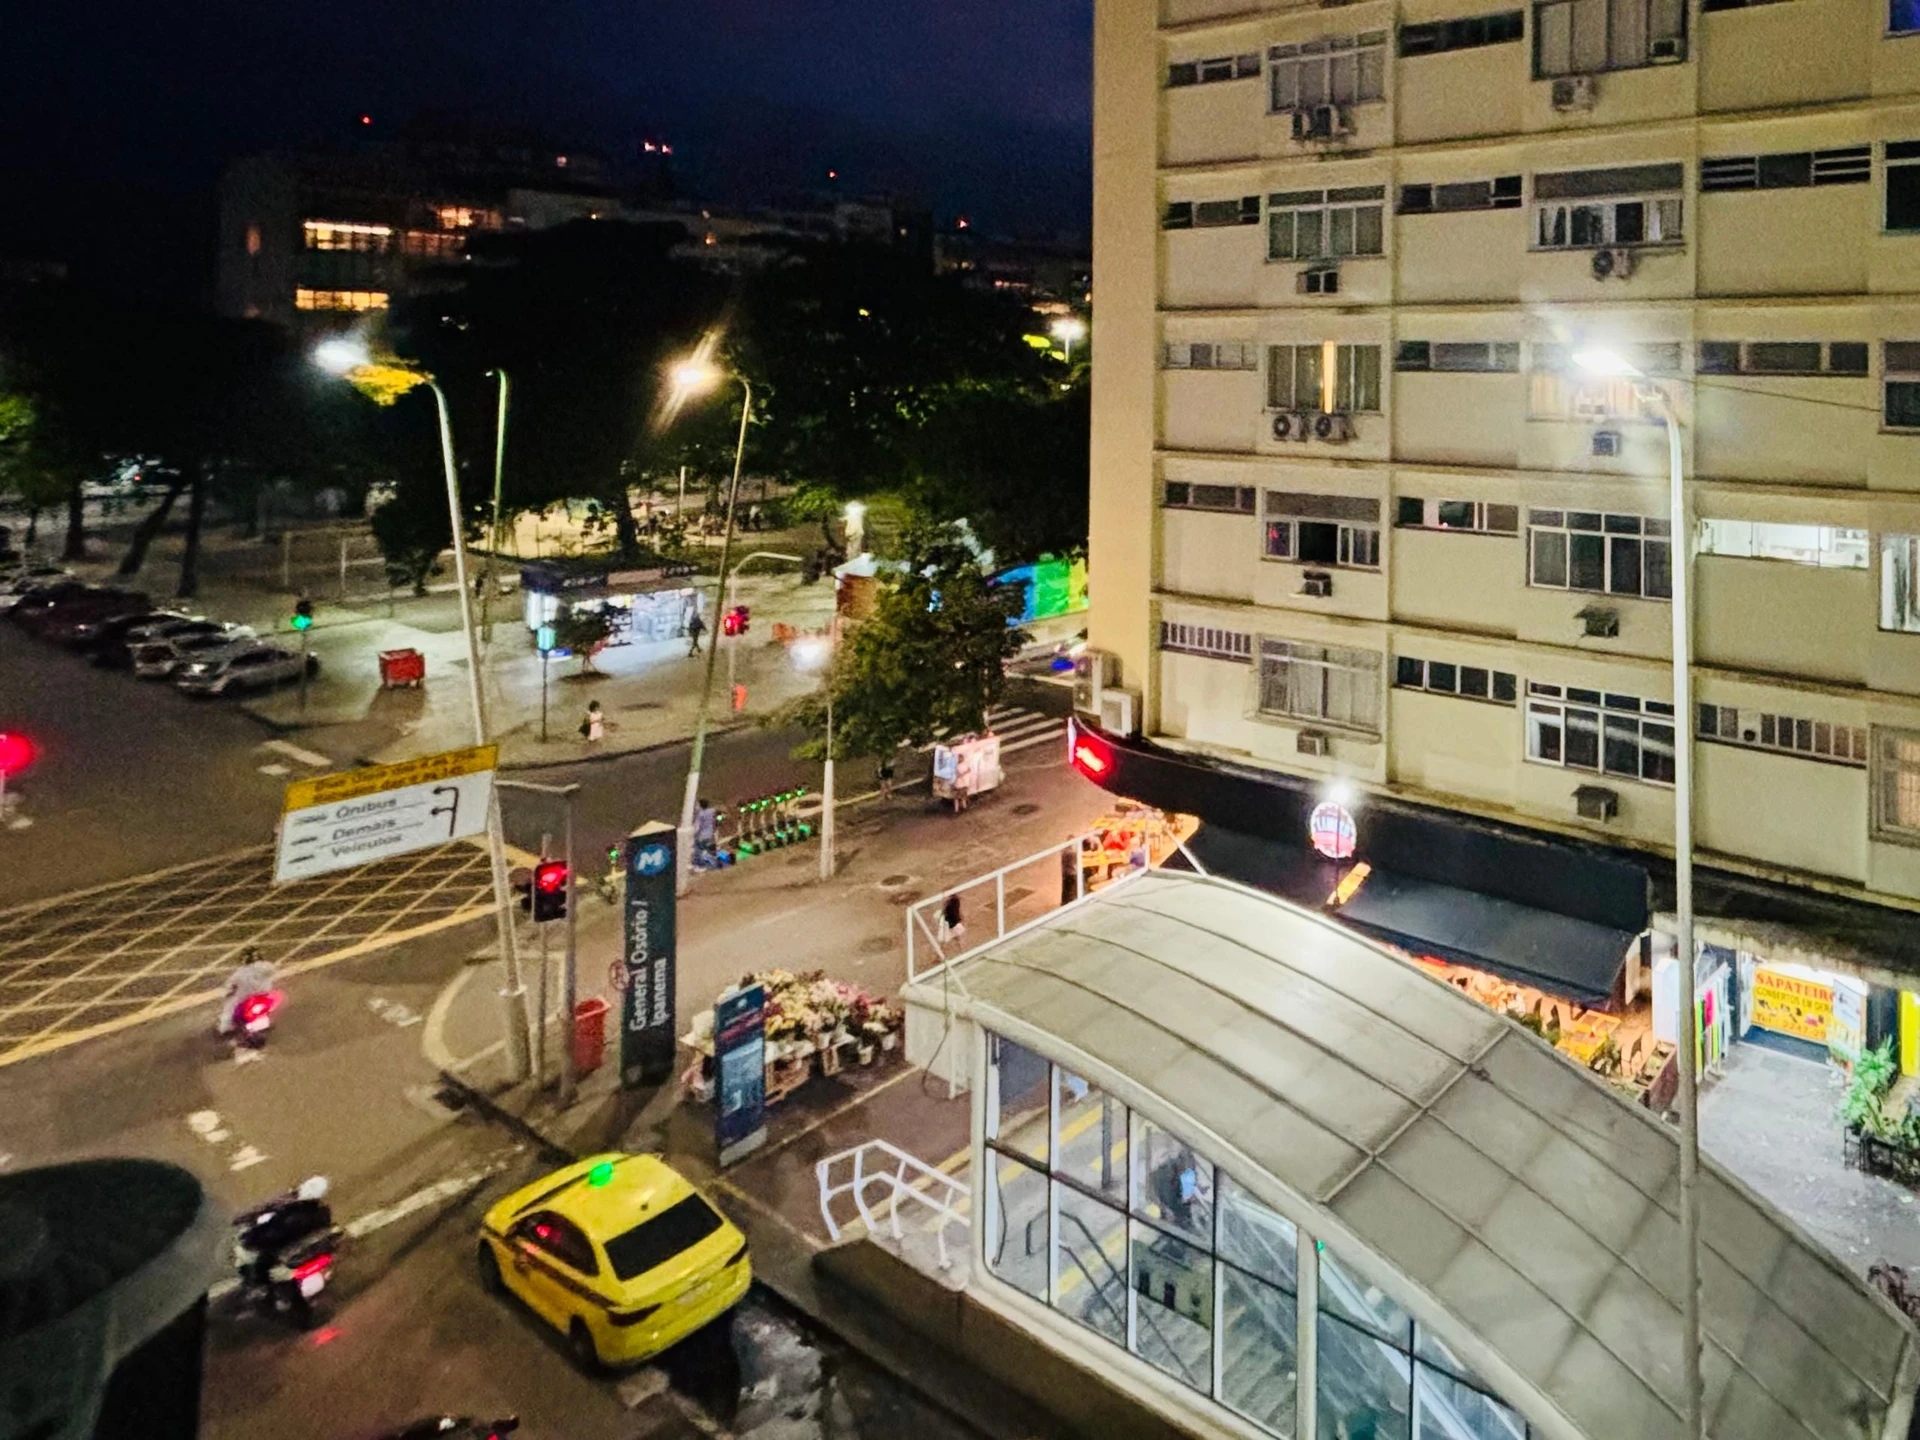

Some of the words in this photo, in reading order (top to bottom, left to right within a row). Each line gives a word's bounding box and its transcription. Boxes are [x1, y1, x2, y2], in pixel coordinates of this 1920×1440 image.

[332, 819, 396, 841] Demais
[630, 908, 648, 964] Osório
[629, 967, 648, 1032] General
[650, 956, 670, 1028] Ipanema
